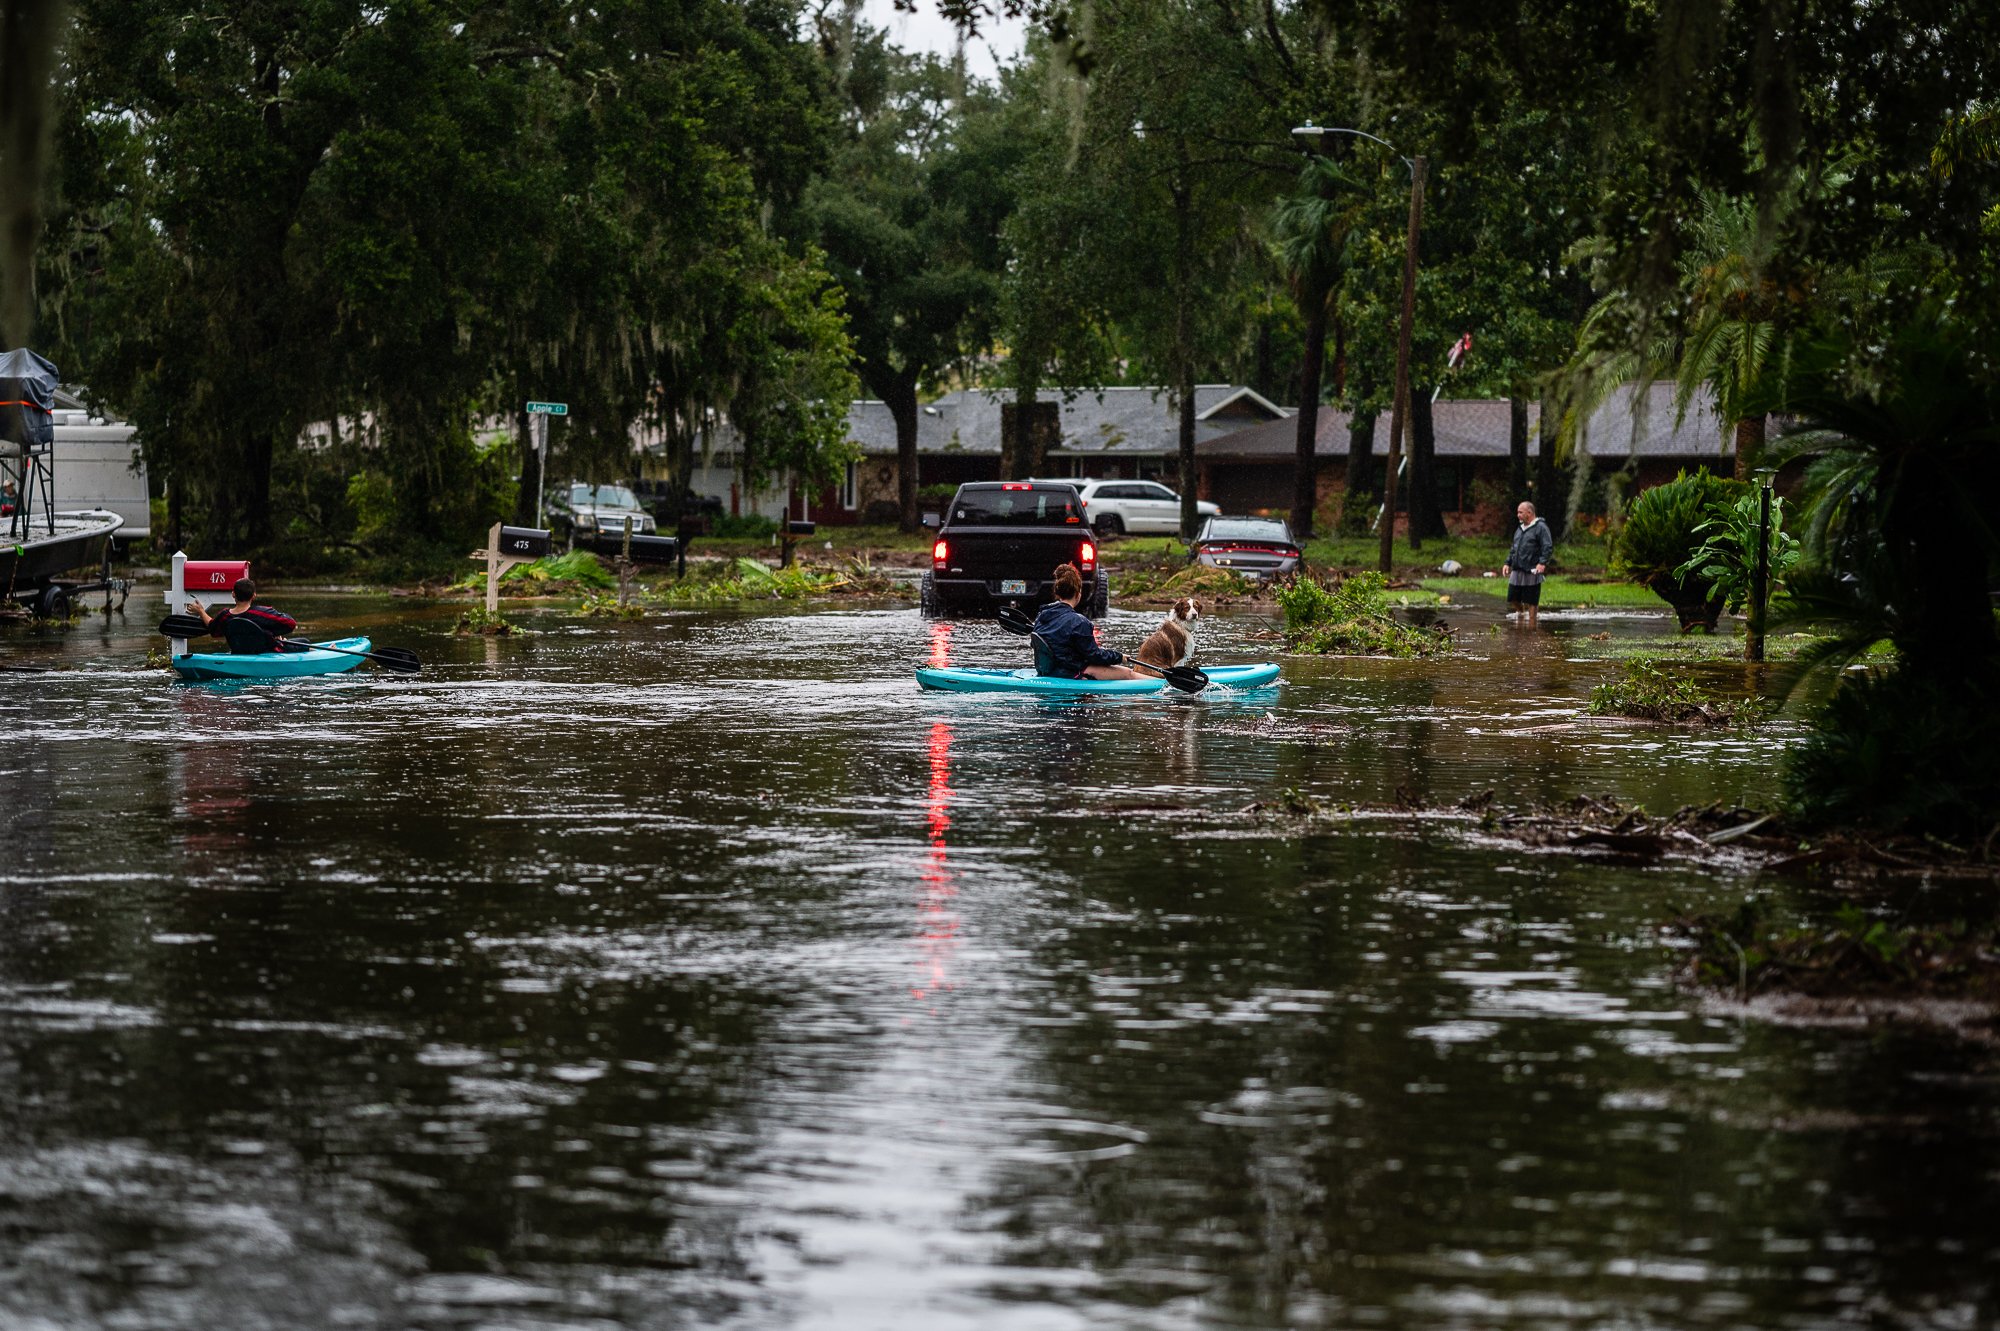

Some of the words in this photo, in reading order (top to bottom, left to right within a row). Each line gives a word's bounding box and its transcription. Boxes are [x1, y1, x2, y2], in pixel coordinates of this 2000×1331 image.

[532, 403, 552, 414] Apple
[513, 540, 530, 550] 475
[210, 572, 226, 584] 478
